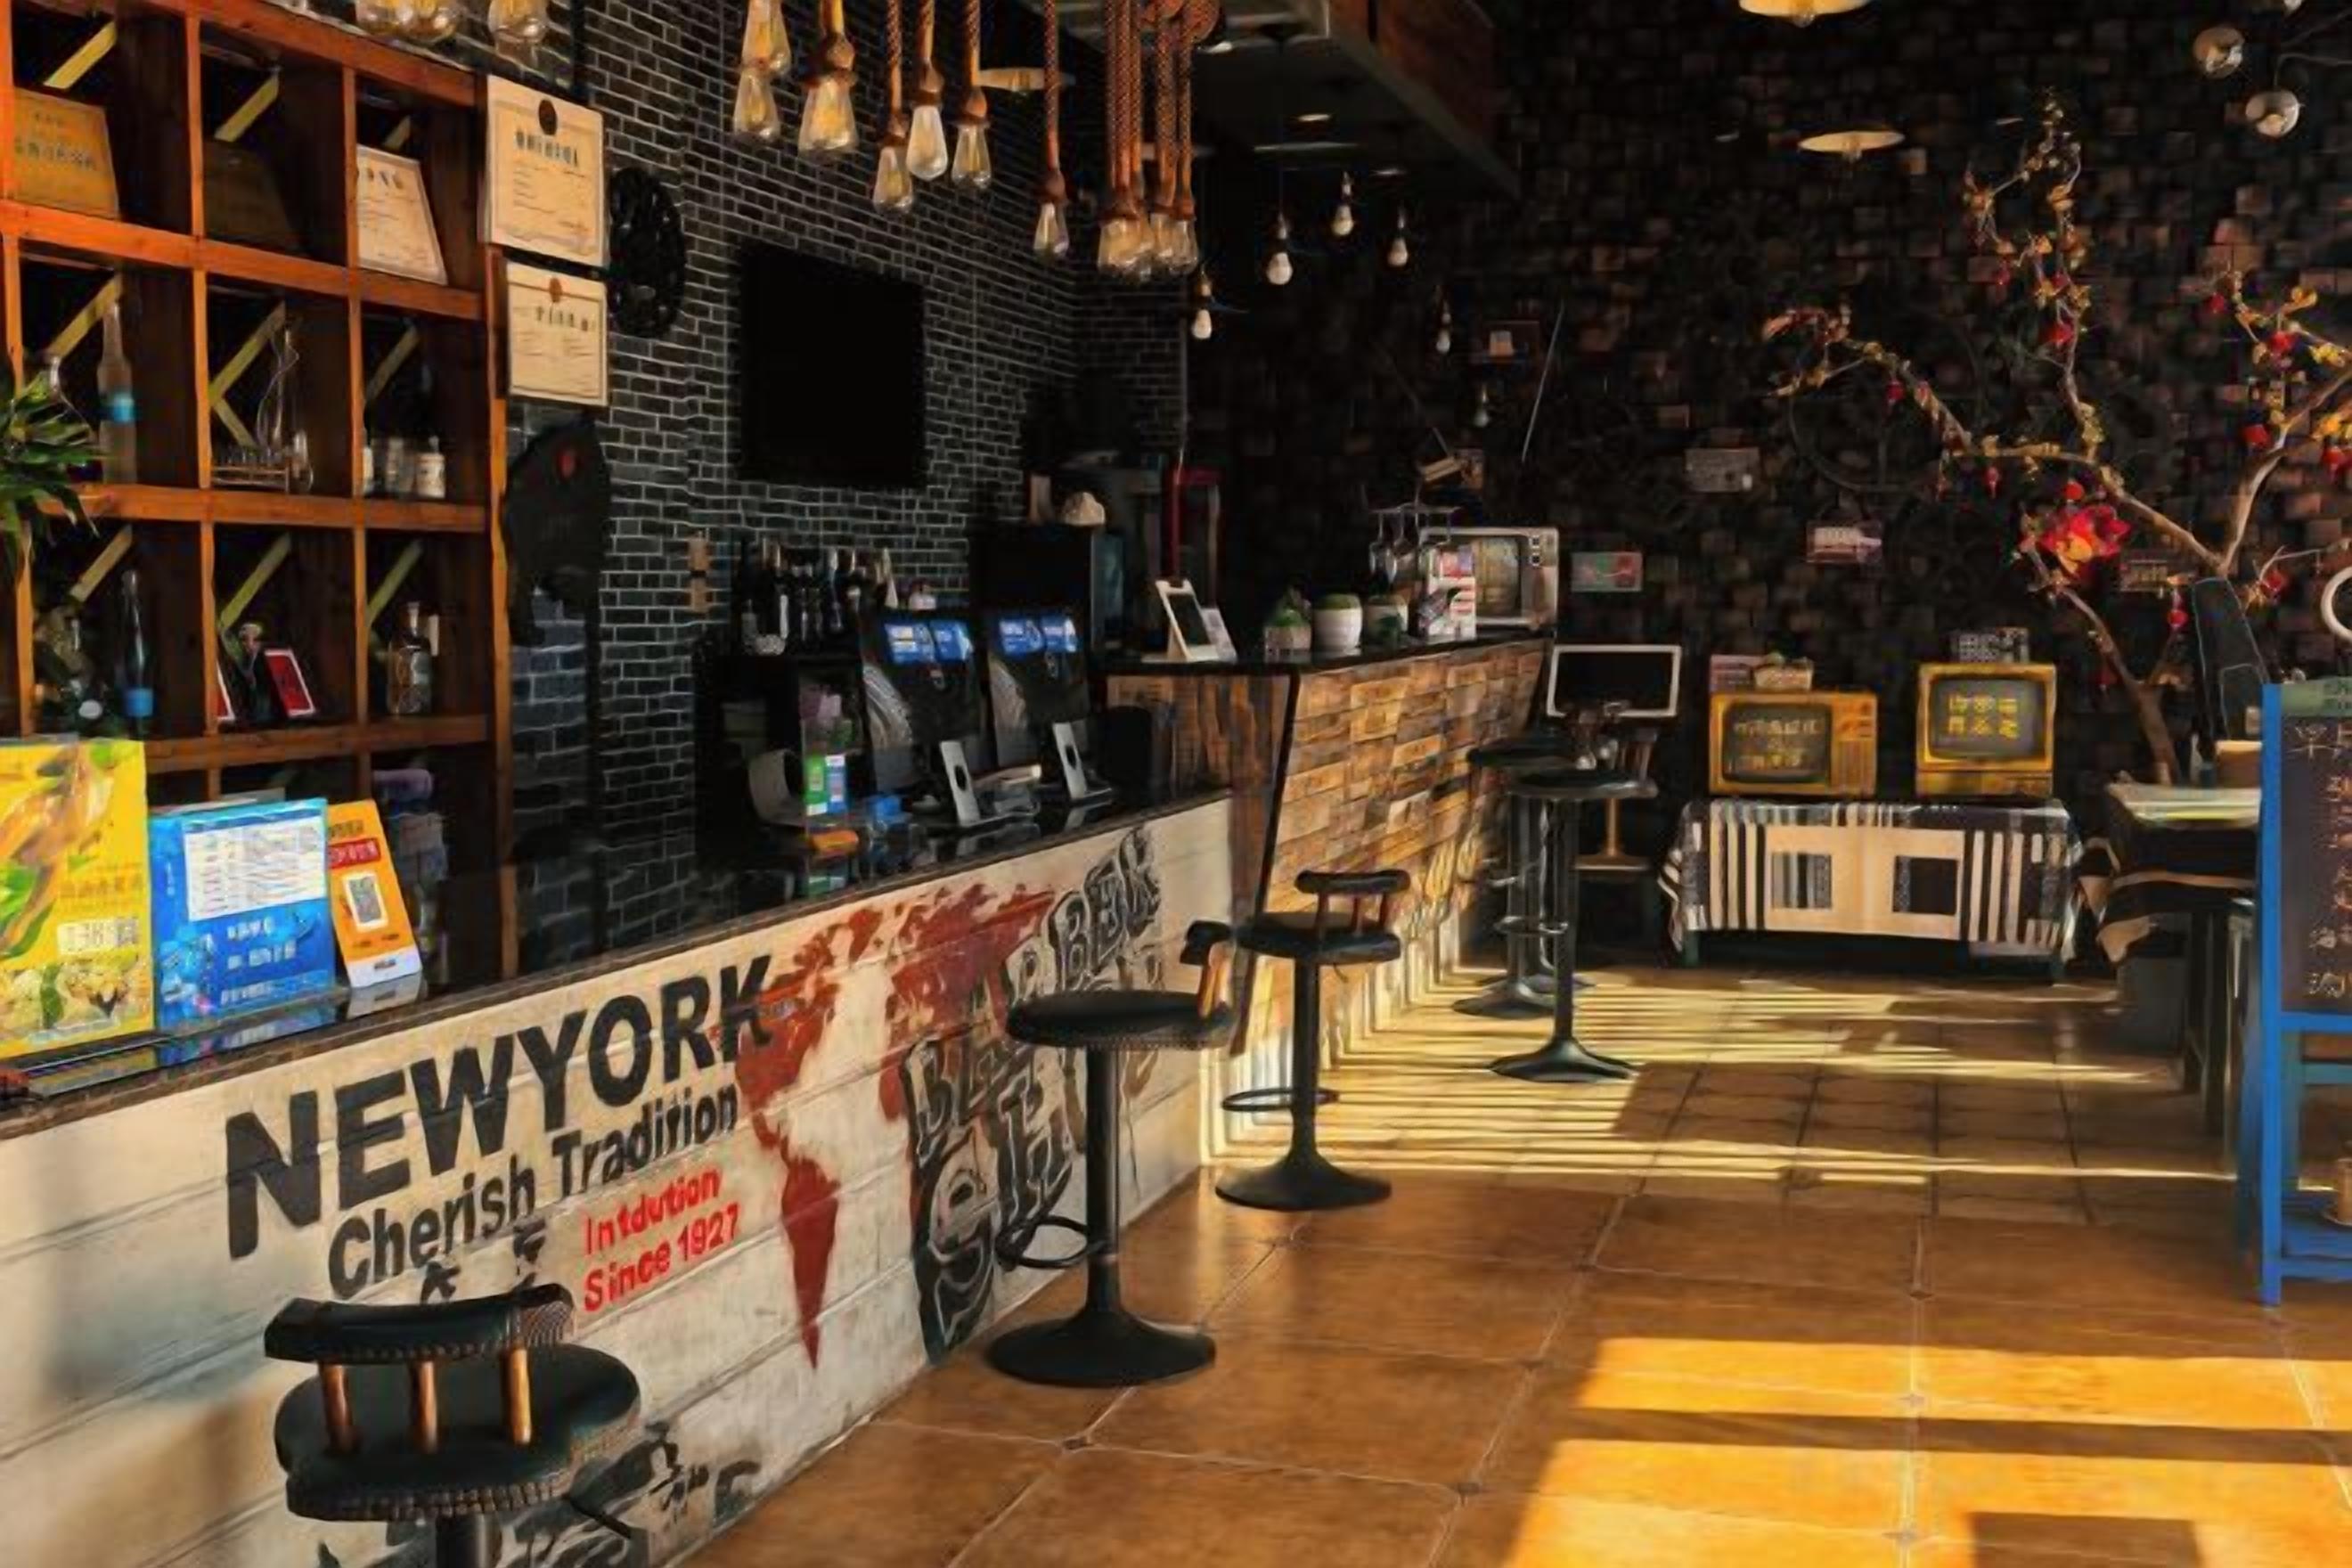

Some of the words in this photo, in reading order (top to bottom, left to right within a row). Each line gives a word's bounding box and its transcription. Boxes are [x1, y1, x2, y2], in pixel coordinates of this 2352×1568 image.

[328, 1156, 536, 1300] Cherish
[551, 1083, 739, 1205] Tradition
[584, 1240, 672, 1312] Since
[677, 1201, 739, 1262] 1927
